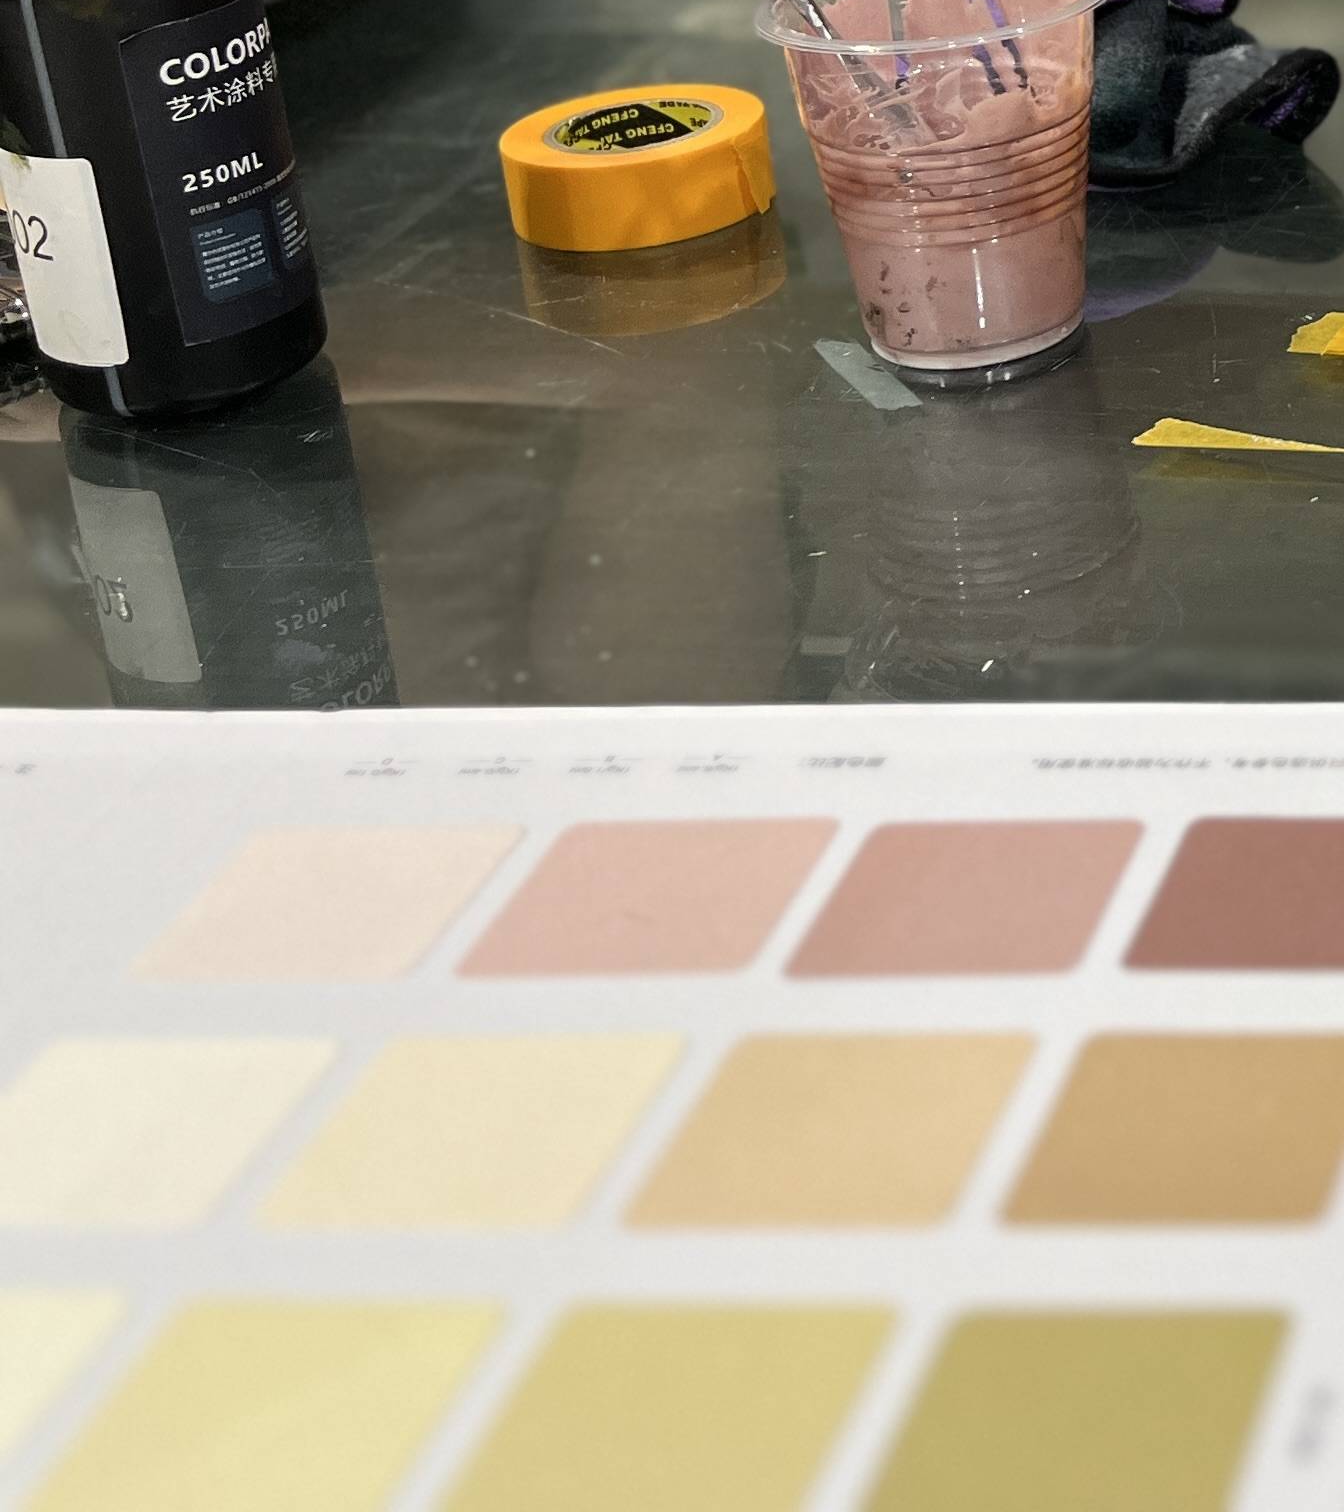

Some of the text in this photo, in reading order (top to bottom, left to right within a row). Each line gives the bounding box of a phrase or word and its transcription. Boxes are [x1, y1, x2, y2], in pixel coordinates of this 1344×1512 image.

[625, 122, 675, 139] CFENG
[182, 151, 264, 193] 250ML
[12, 210, 54, 261] 02
